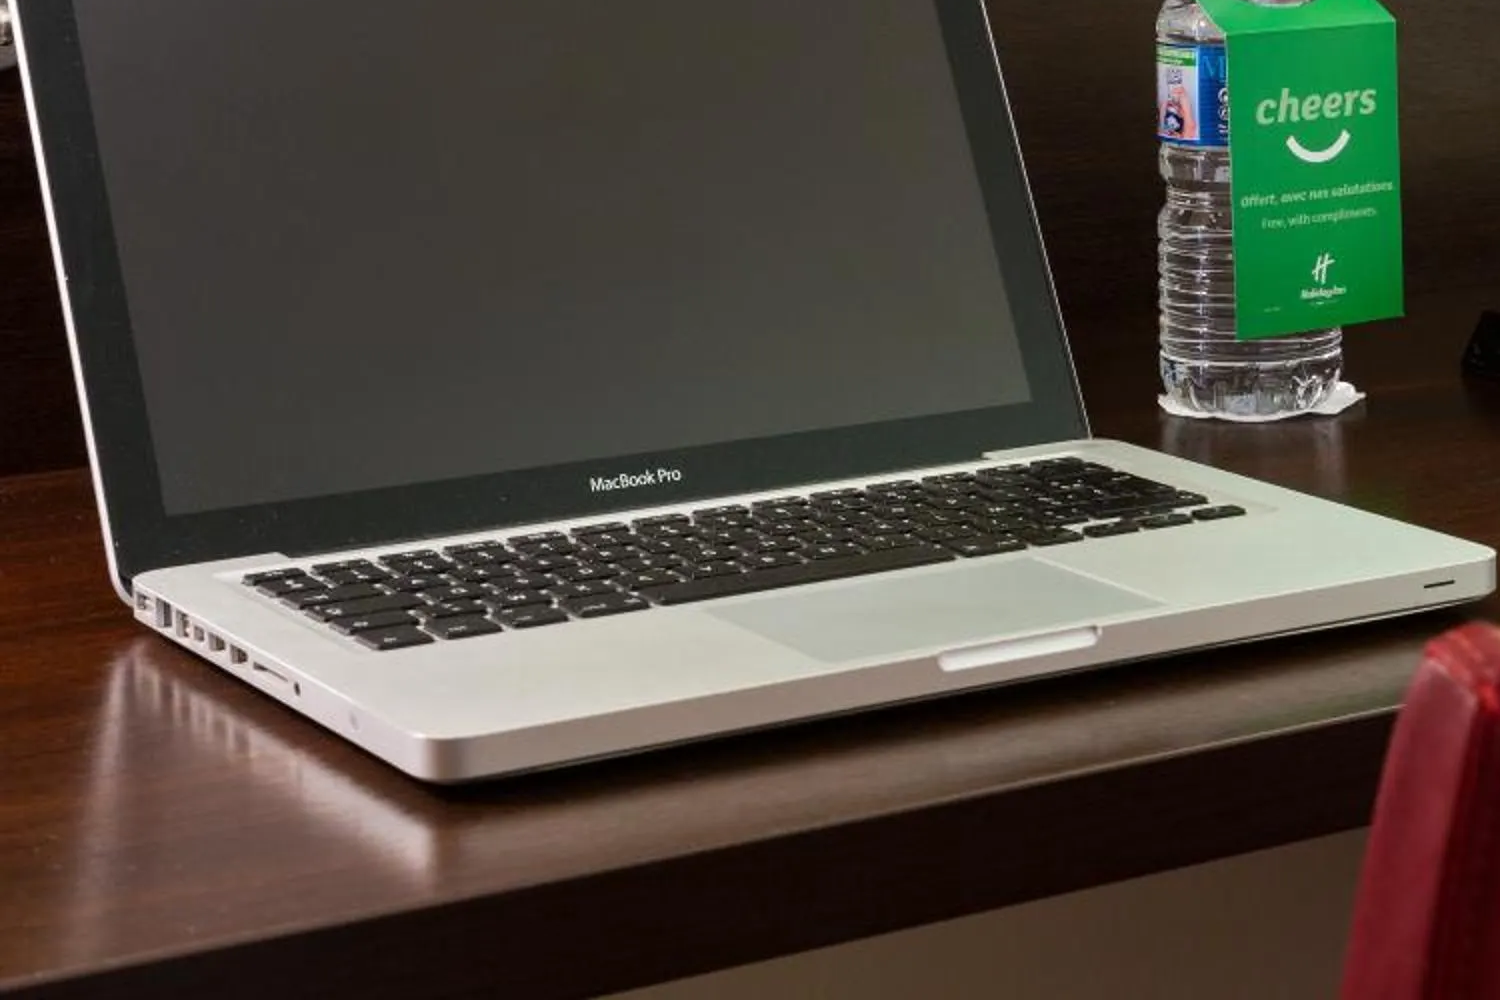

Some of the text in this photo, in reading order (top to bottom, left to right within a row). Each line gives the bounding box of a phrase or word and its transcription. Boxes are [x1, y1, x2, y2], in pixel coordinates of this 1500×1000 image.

[1256, 88, 1377, 125] cheers
[1288, 213, 1310, 227] with
[590, 467, 682, 492] MacBook Pro
